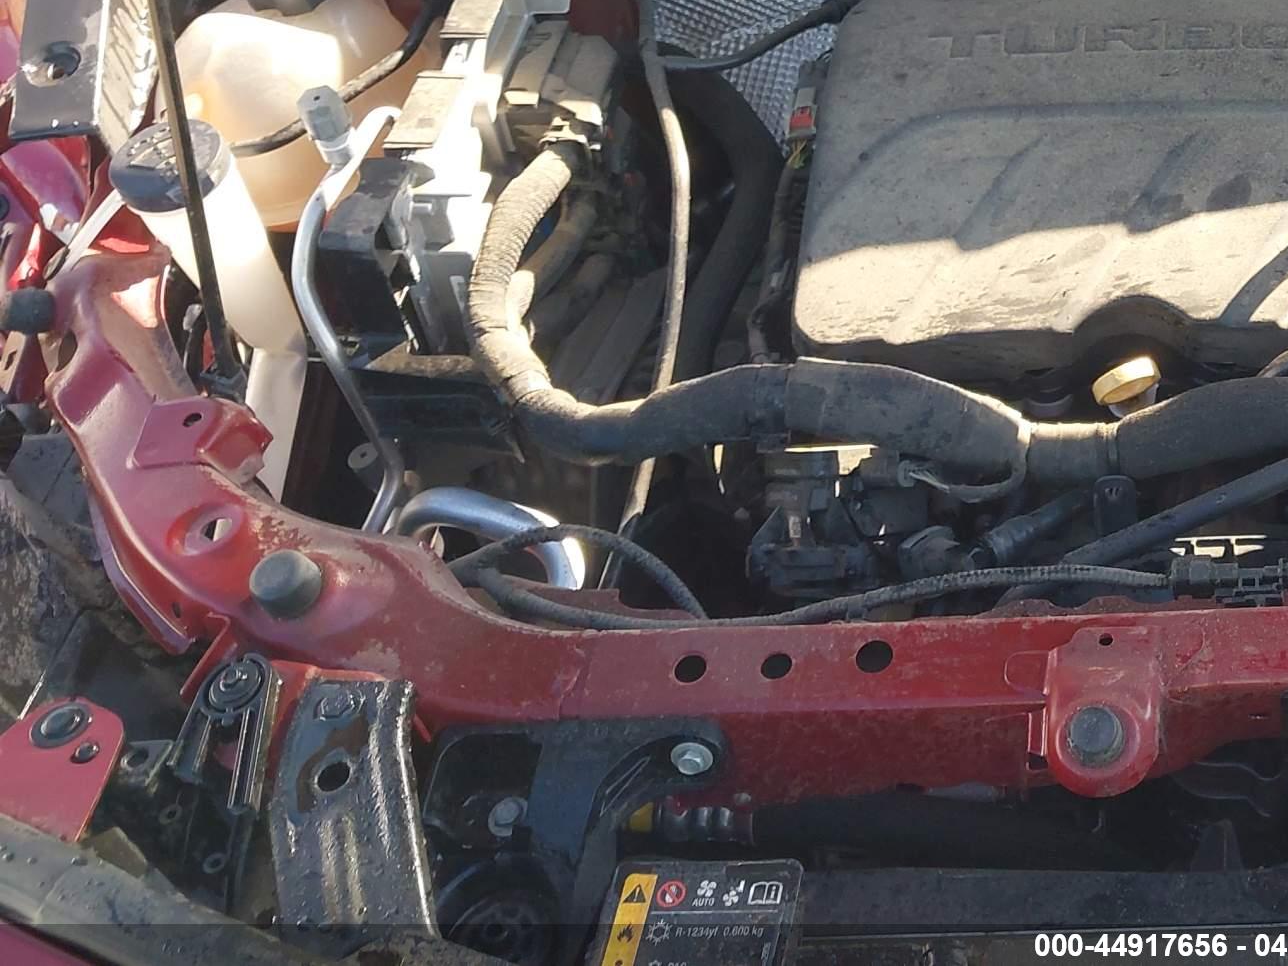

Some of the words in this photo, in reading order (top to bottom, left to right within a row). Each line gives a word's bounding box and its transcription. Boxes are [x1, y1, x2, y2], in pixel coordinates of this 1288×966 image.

[692, 898, 714, 907] AUTO
[675, 926, 719, 939] R-1234yf
[751, 925, 764, 937] kg
